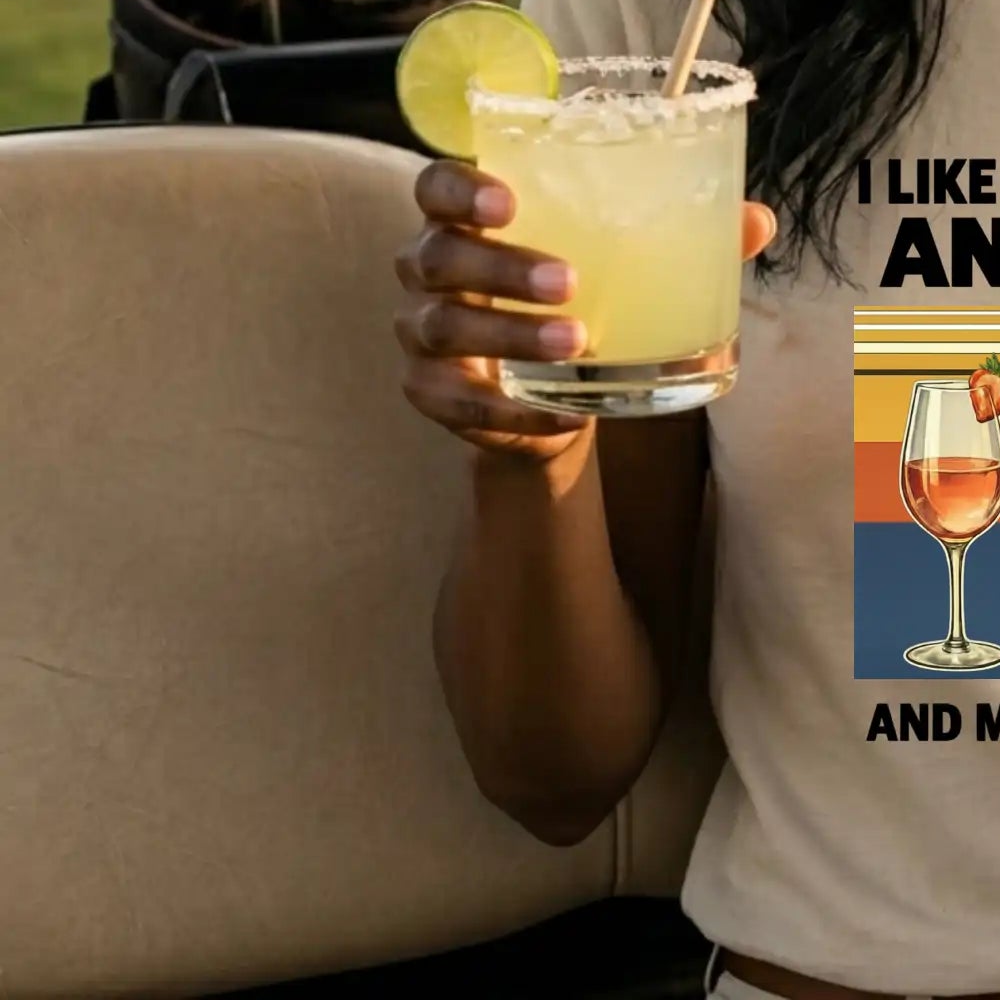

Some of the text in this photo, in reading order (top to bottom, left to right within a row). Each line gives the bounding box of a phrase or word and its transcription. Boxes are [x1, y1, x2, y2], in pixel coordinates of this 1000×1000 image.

[858, 158, 871, 205] I
[887, 158, 997, 205] LIKE
[866, 702, 963, 742] AND
